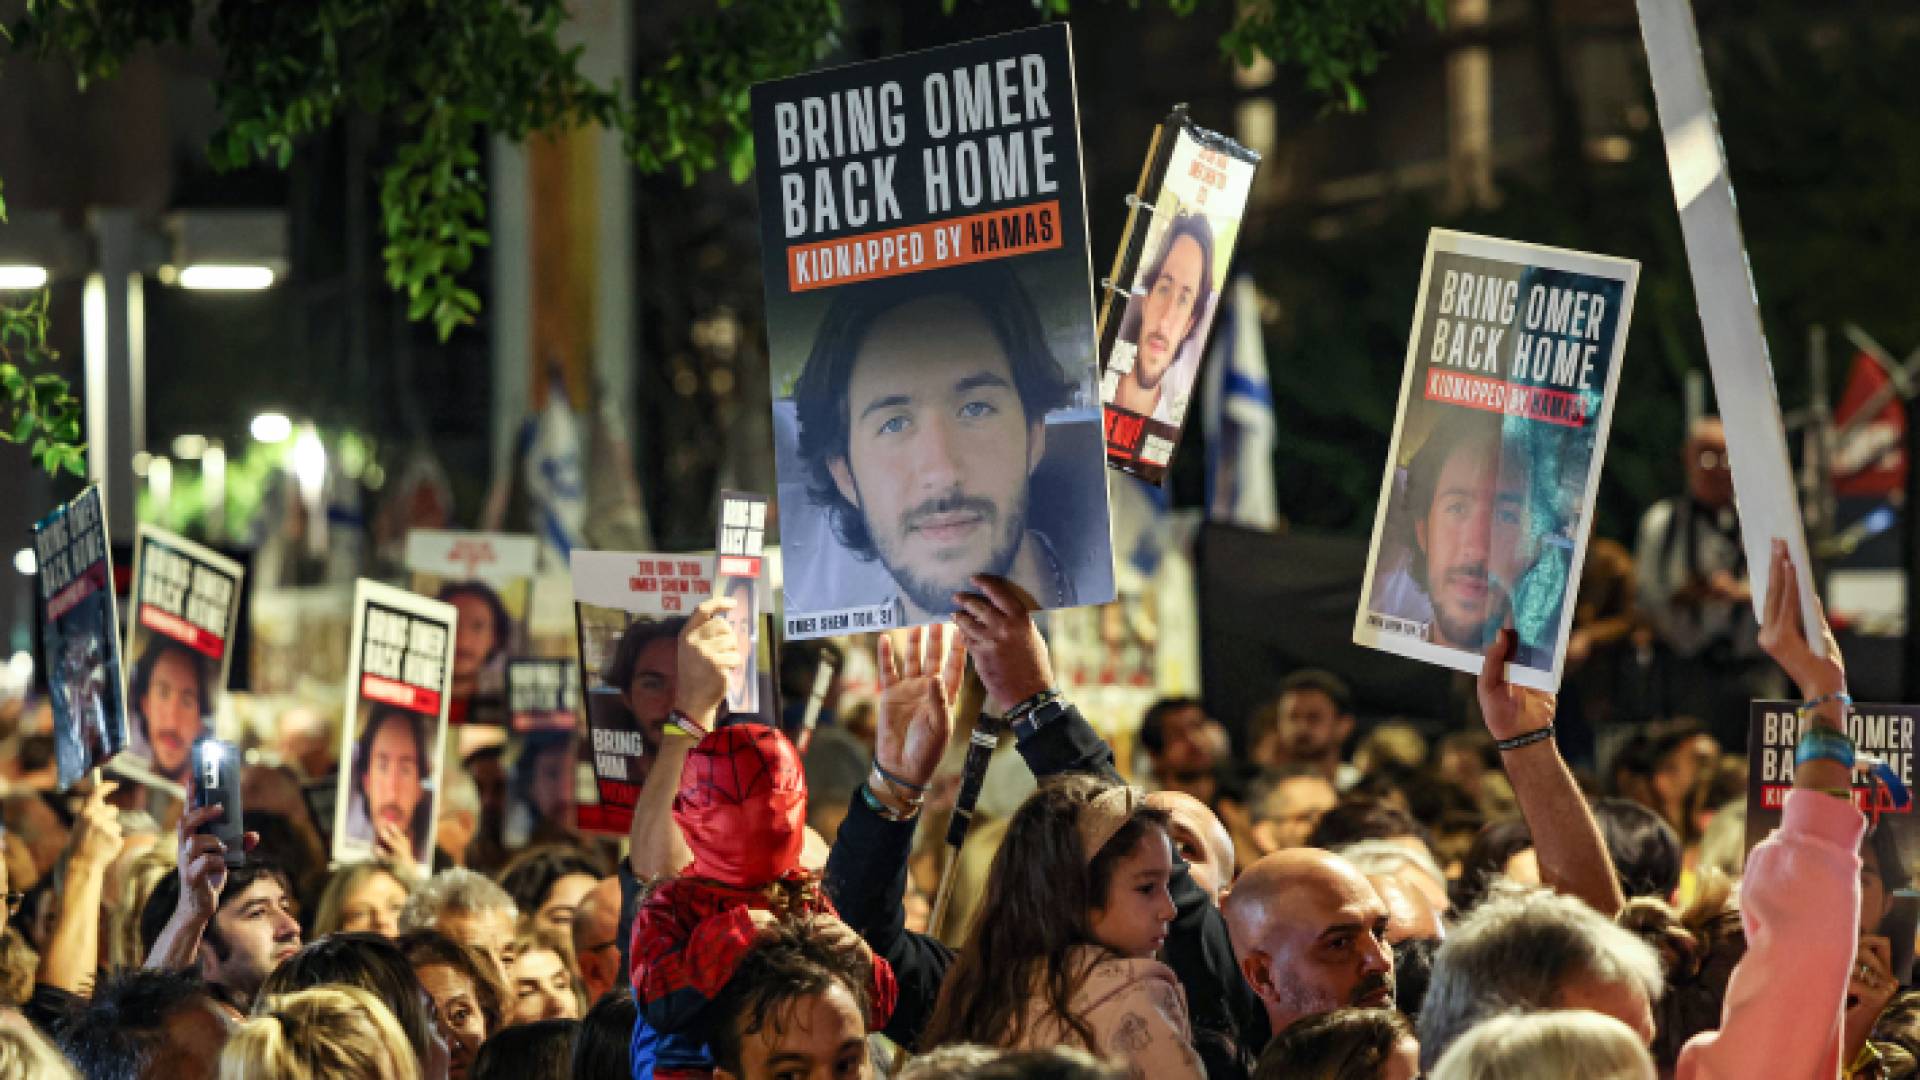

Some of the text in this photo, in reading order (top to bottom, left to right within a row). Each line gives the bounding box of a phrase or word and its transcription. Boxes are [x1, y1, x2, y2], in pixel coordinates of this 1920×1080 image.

[775, 54, 1050, 167] BRING OMER
[781, 127, 1058, 238] BACK HOME
[796, 210, 1053, 284] KIDNAPPED BY HAMAS
[1439, 270, 1605, 340] BRING OMER
[1431, 319, 1599, 389] BACK HOME
[1429, 372, 1505, 409] KIDNAPPED
[593, 728, 644, 757] BRING
[1852, 714, 1912, 749] OMER
